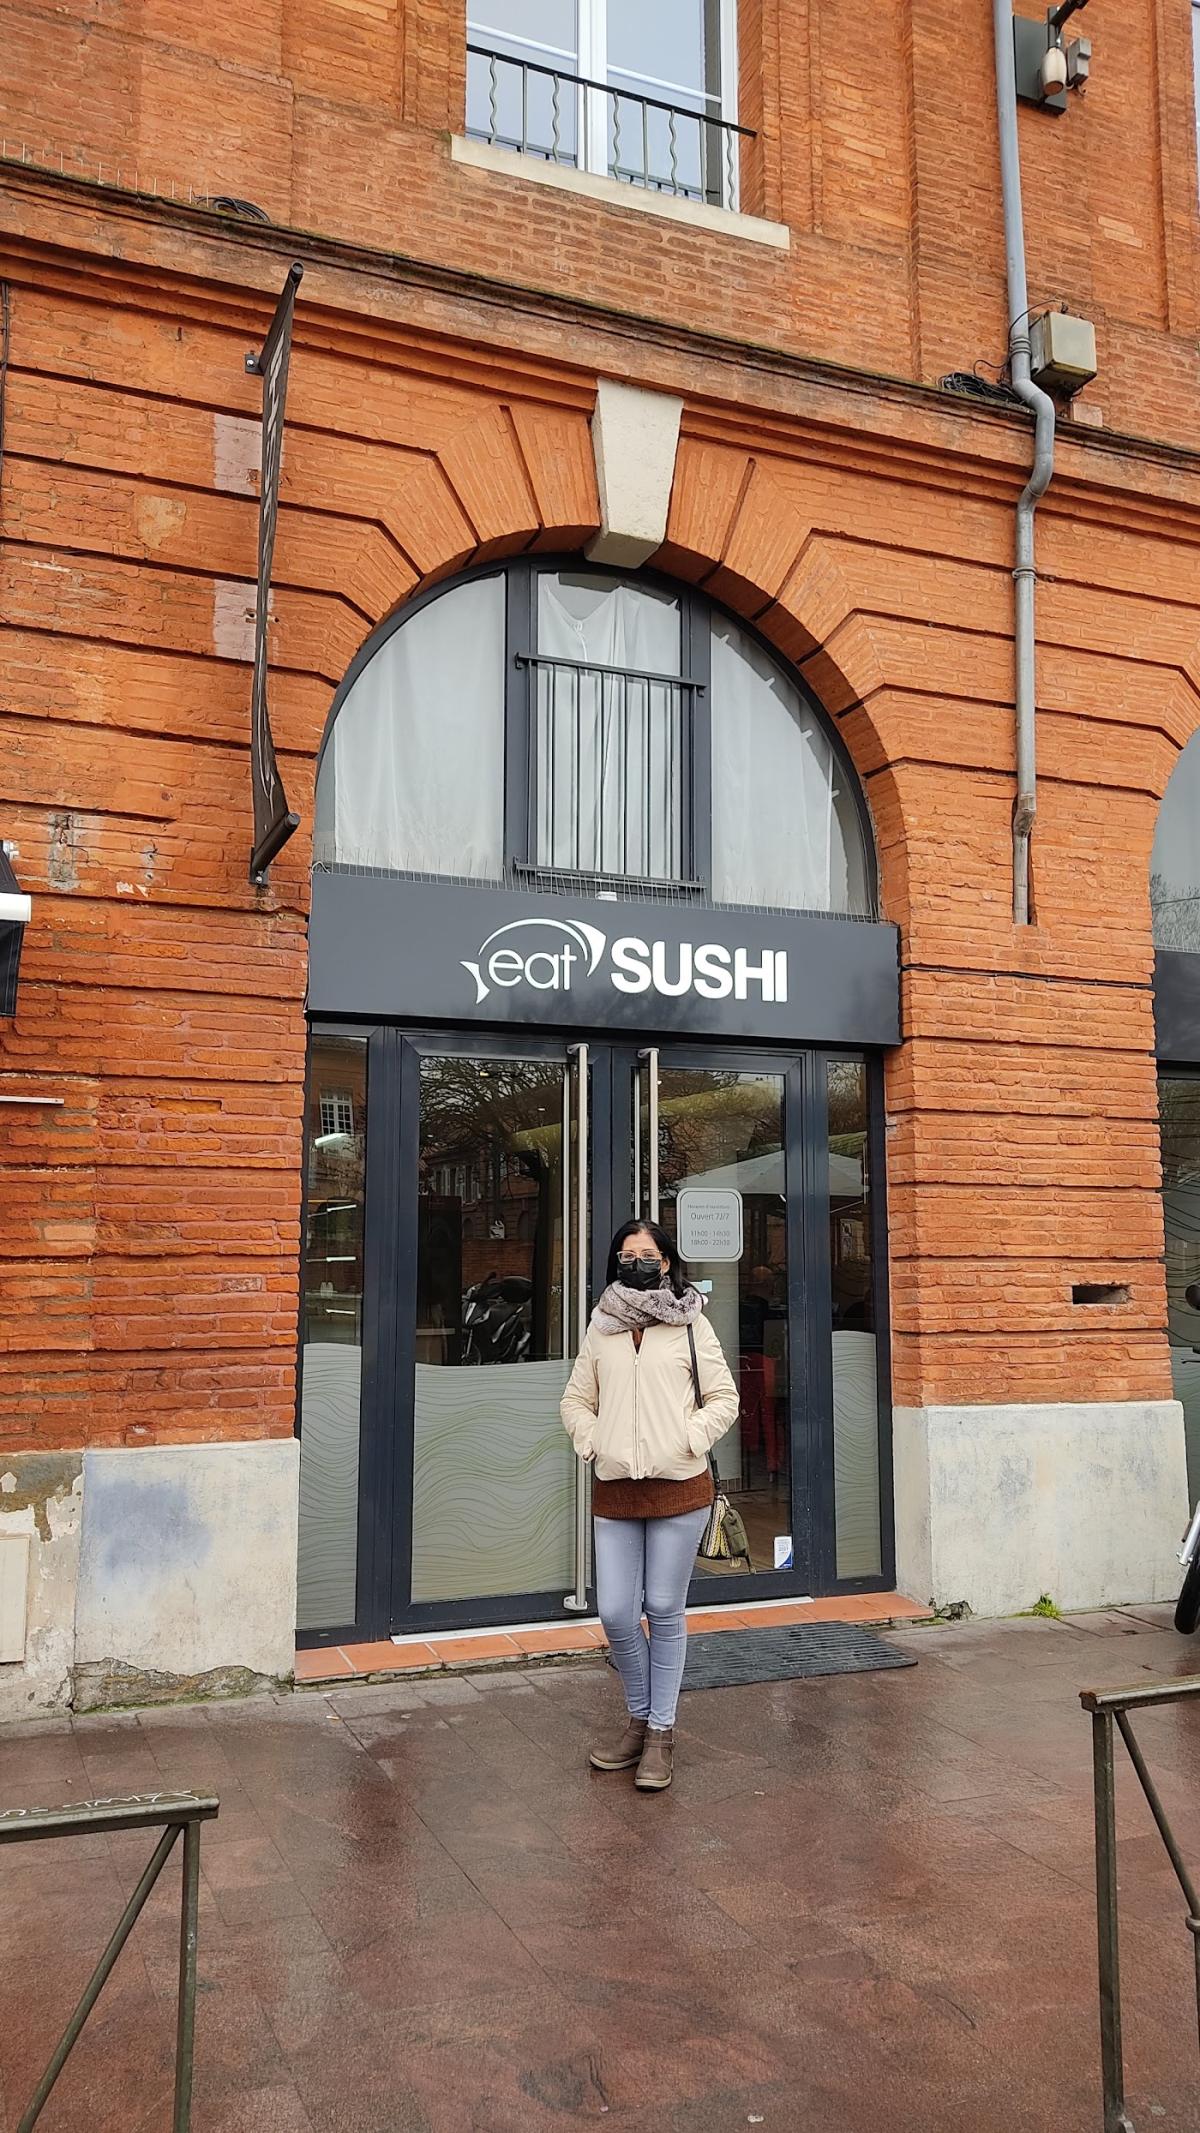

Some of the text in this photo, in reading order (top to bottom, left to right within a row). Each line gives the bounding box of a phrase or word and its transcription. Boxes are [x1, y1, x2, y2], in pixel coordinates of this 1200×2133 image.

[488, 936, 788, 1002] eat SUSHI
[690, 1212, 714, 1221] Ouvert
